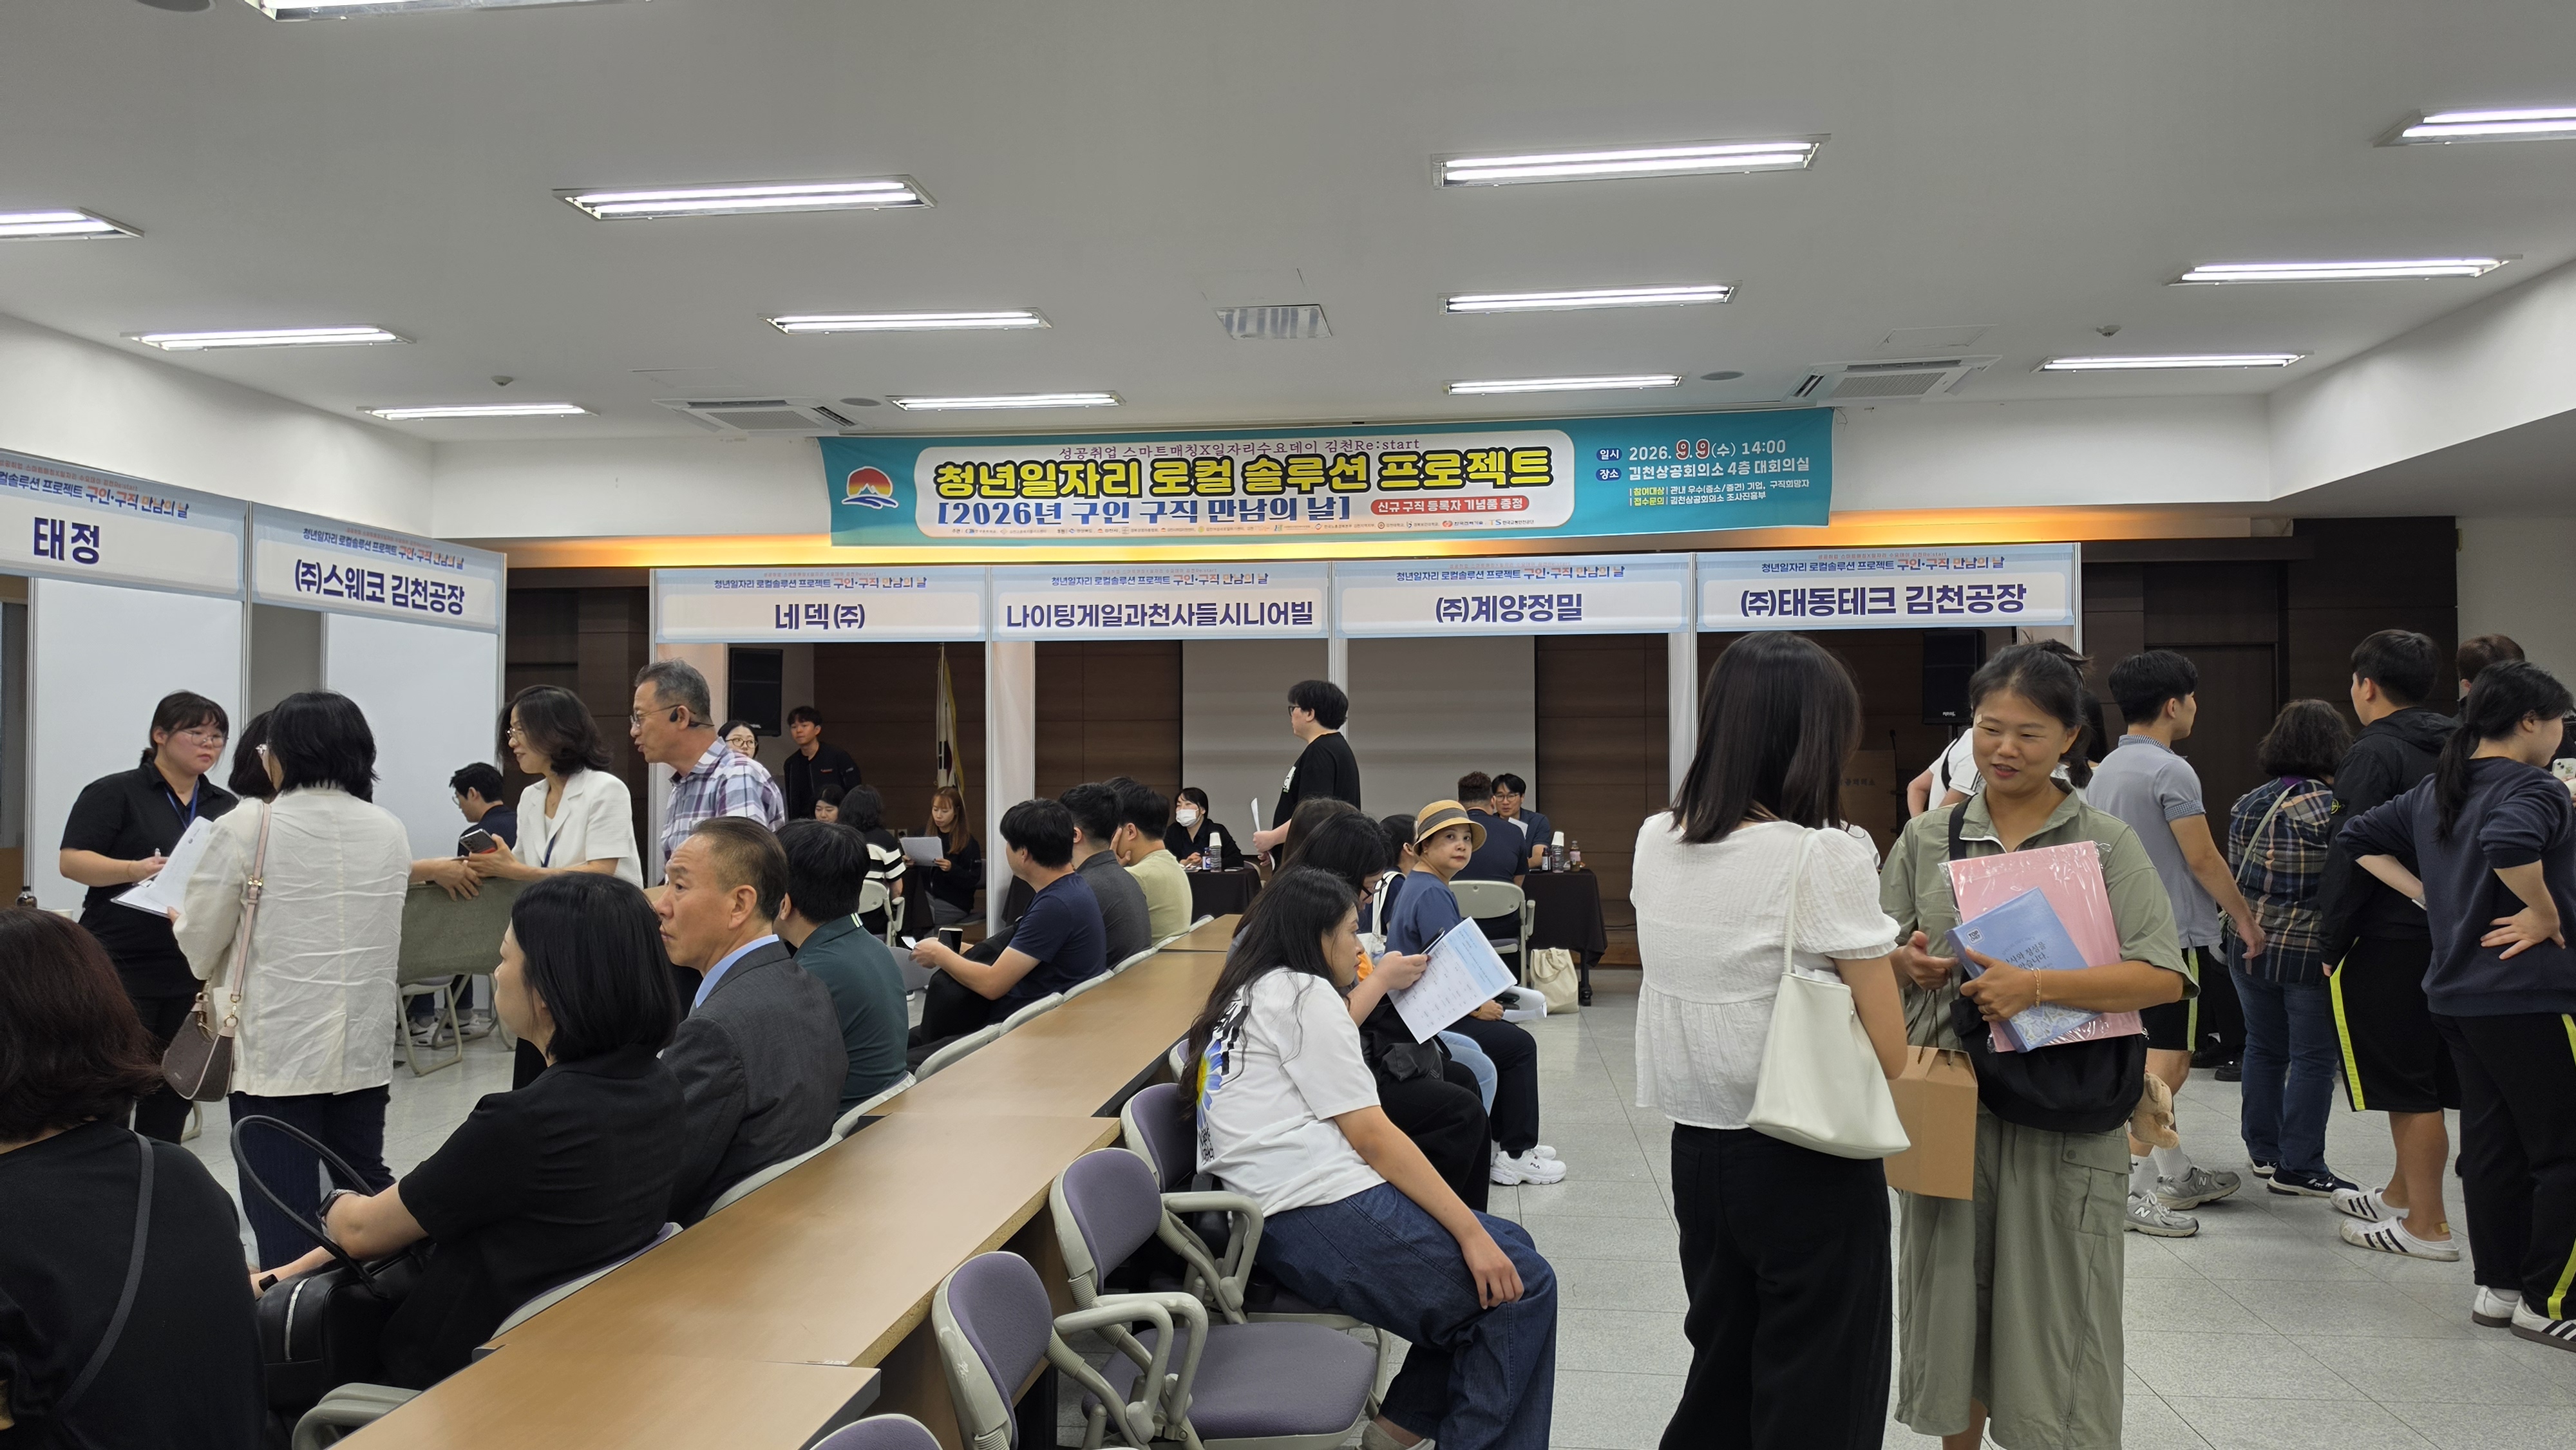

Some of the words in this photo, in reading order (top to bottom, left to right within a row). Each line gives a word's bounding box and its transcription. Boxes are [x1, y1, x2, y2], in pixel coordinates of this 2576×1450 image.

[1059, 446, 1117, 460] 성공취업
[1327, 438, 1419, 453] 김천Re:start
[1600, 449, 1620, 460] 일시
[1741, 439, 1786, 455] 14:00
[934, 458, 1143, 499] 청년일자리
[1150, 456, 1235, 496] 로컬
[1242, 453, 1370, 495] 솔루션
[1378, 447, 1554, 490] 프로젝트
[1600, 469, 1620, 480] 장소
[1629, 462, 1725, 480] 김천상공회의소
[1727, 461, 1751, 476] 4층
[1754, 457, 1810, 475] 대회의실
[0, 471, 40, 491] 컬솔루션
[43, 479, 83, 498] 프로젝트
[141, 495, 175, 517] 만남의
[177, 503, 189, 519] 날
[1671, 486, 1686, 494] 관내
[1747, 482, 1766, 490] 기업,
[1770, 479, 1810, 489] 구직희망자
[1378, 502, 1400, 513] 신규
[1403, 501, 1425, 512] 구직
[1428, 500, 1461, 512] 등록자
[1464, 498, 1497, 511] 기념품
[1500, 498, 1523, 510] 증정
[1671, 494, 1725, 505] 김천상공회의소
[1727, 491, 1766, 502] 조사진흥부
[1070, 500, 1131, 525] 구인
[1139, 499, 1198, 524] 구직
[1208, 498, 1297, 523] 만남의
[33, 516, 100, 565] 태정
[303, 528, 338, 544] 청년일자리
[339, 535, 372, 551] 로컬솔루션
[372, 541, 397, 556] 프로젝트
[1396, 572, 1439, 582] 청년일자리
[1441, 570, 1484, 581] 로컬솔루션
[1486, 569, 1522, 579] 프로젝트
[1576, 567, 1610, 578] 만남의
[1613, 566, 1625, 578] 날
[1761, 563, 1807, 572] 청년일자리
[1809, 561, 1855, 572] 로컬솔루션
[1857, 560, 1895, 570] 프로젝트
[1953, 557, 1989, 569] 만남의
[1992, 556, 2005, 569] 날
[295, 559, 385, 603] (주)스웨코
[391, 574, 465, 616] 김천공장
[714, 579, 754, 589] 청년일자리
[756, 579, 797, 588] 로컬솔루션
[799, 579, 831, 588] 프로젝트
[882, 577, 913, 588] 만남의
[916, 577, 927, 588] 날
[1051, 577, 1092, 587] 청년일자리
[1094, 576, 1135, 586] 로컬솔루션
[1137, 576, 1171, 585] 프로젝트
[1222, 574, 1255, 585] 만남의
[1258, 573, 1269, 585] 날
[1435, 594, 1583, 623] (주)계양정밀
[1740, 587, 1897, 617] (주)태동테크
[1904, 583, 2027, 616] 김천공장
[1007, 601, 1313, 629] 나이팅게일과천사들시니어빌
[1968, 930, 1979, 938] TOP
[2025, 941, 2047, 957] 정성을
[2018, 952, 2050, 970] 았습니다.
